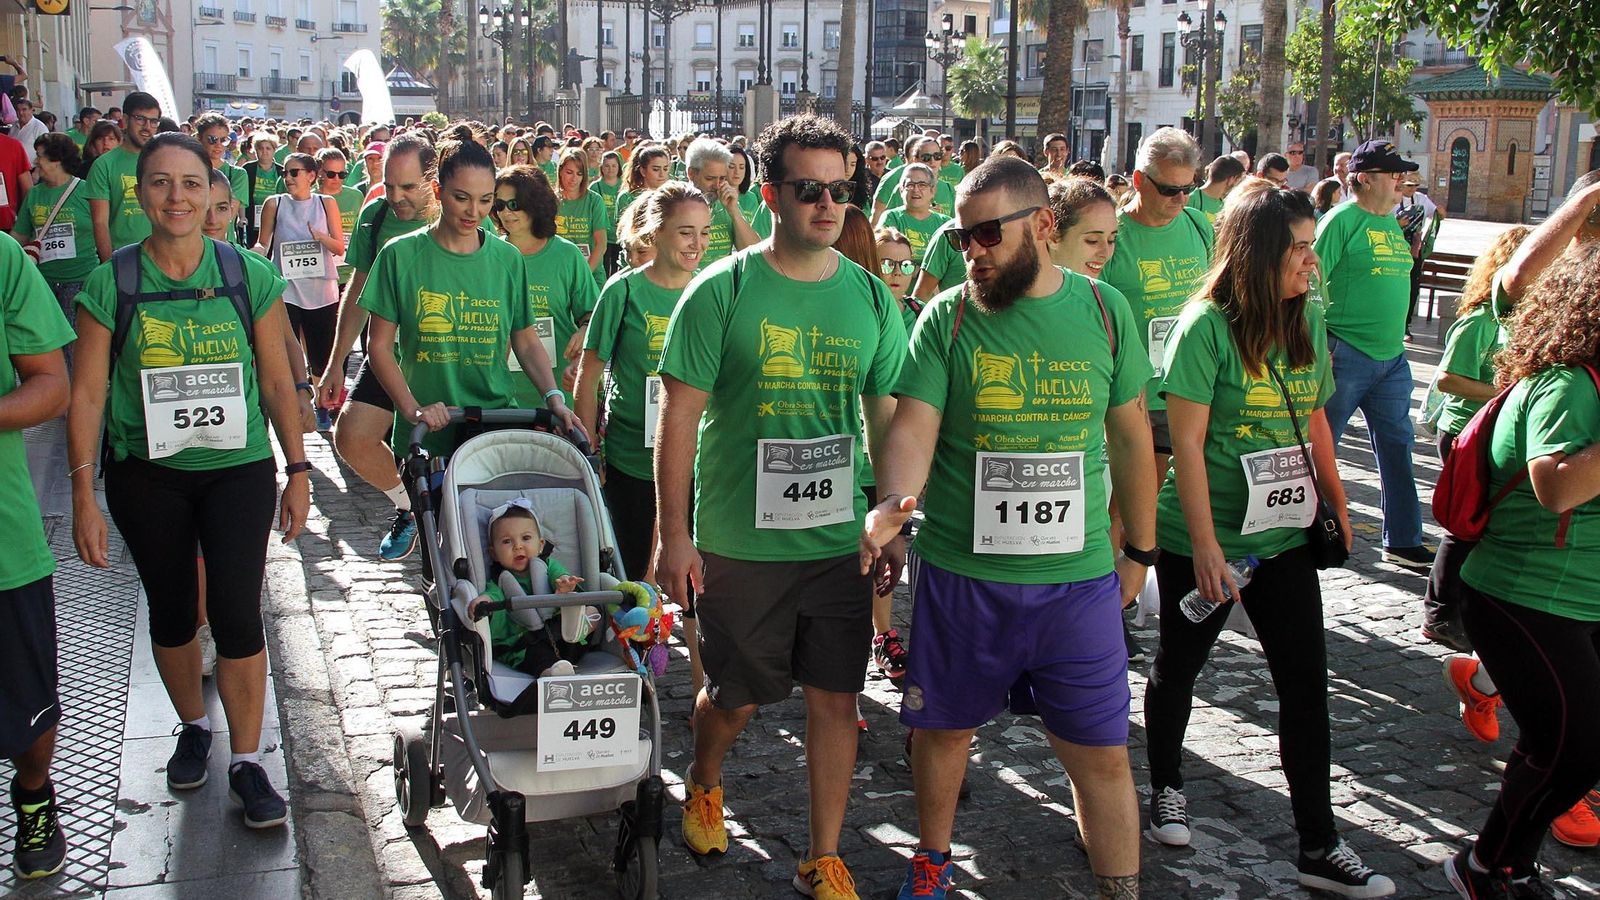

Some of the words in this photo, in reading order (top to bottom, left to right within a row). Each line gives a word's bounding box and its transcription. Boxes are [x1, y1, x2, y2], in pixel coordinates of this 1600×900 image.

[45, 240, 66, 251] 266
[288, 257, 318, 268] 1753
[470, 298, 500, 308] aecc
[460, 311, 499, 325] HUELVA
[202, 320, 237, 336] aecc
[193, 336, 239, 356] HUELVA
[825, 335, 862, 350] aecc
[811, 351, 859, 369] HUELVA
[1048, 360, 1092, 372] aecc
[185, 371, 228, 387] aecc
[764, 381, 796, 390] MARCHA
[822, 383, 832, 391] EL
[202, 384, 238, 395] marcha
[1035, 378, 1091, 396] HUELVA
[173, 405, 226, 430] 523
[979, 413, 1014, 423] MARCHA
[1015, 412, 1049, 423] CONTRA
[1051, 412, 1061, 422] EL
[994, 434, 1016, 443] Obra
[1016, 434, 1040, 443] Social
[801, 443, 841, 460] aecc
[1279, 454, 1304, 468] aec
[1022, 462, 1071, 477] aecc
[1039, 476, 1079, 488] marcha
[783, 478, 833, 503] 448
[1266, 485, 1306, 508] 683
[995, 500, 1071, 525] 1187
[580, 682, 626, 697] aecc
[595, 694, 634, 707] marcha
[563, 717, 617, 741] 449
